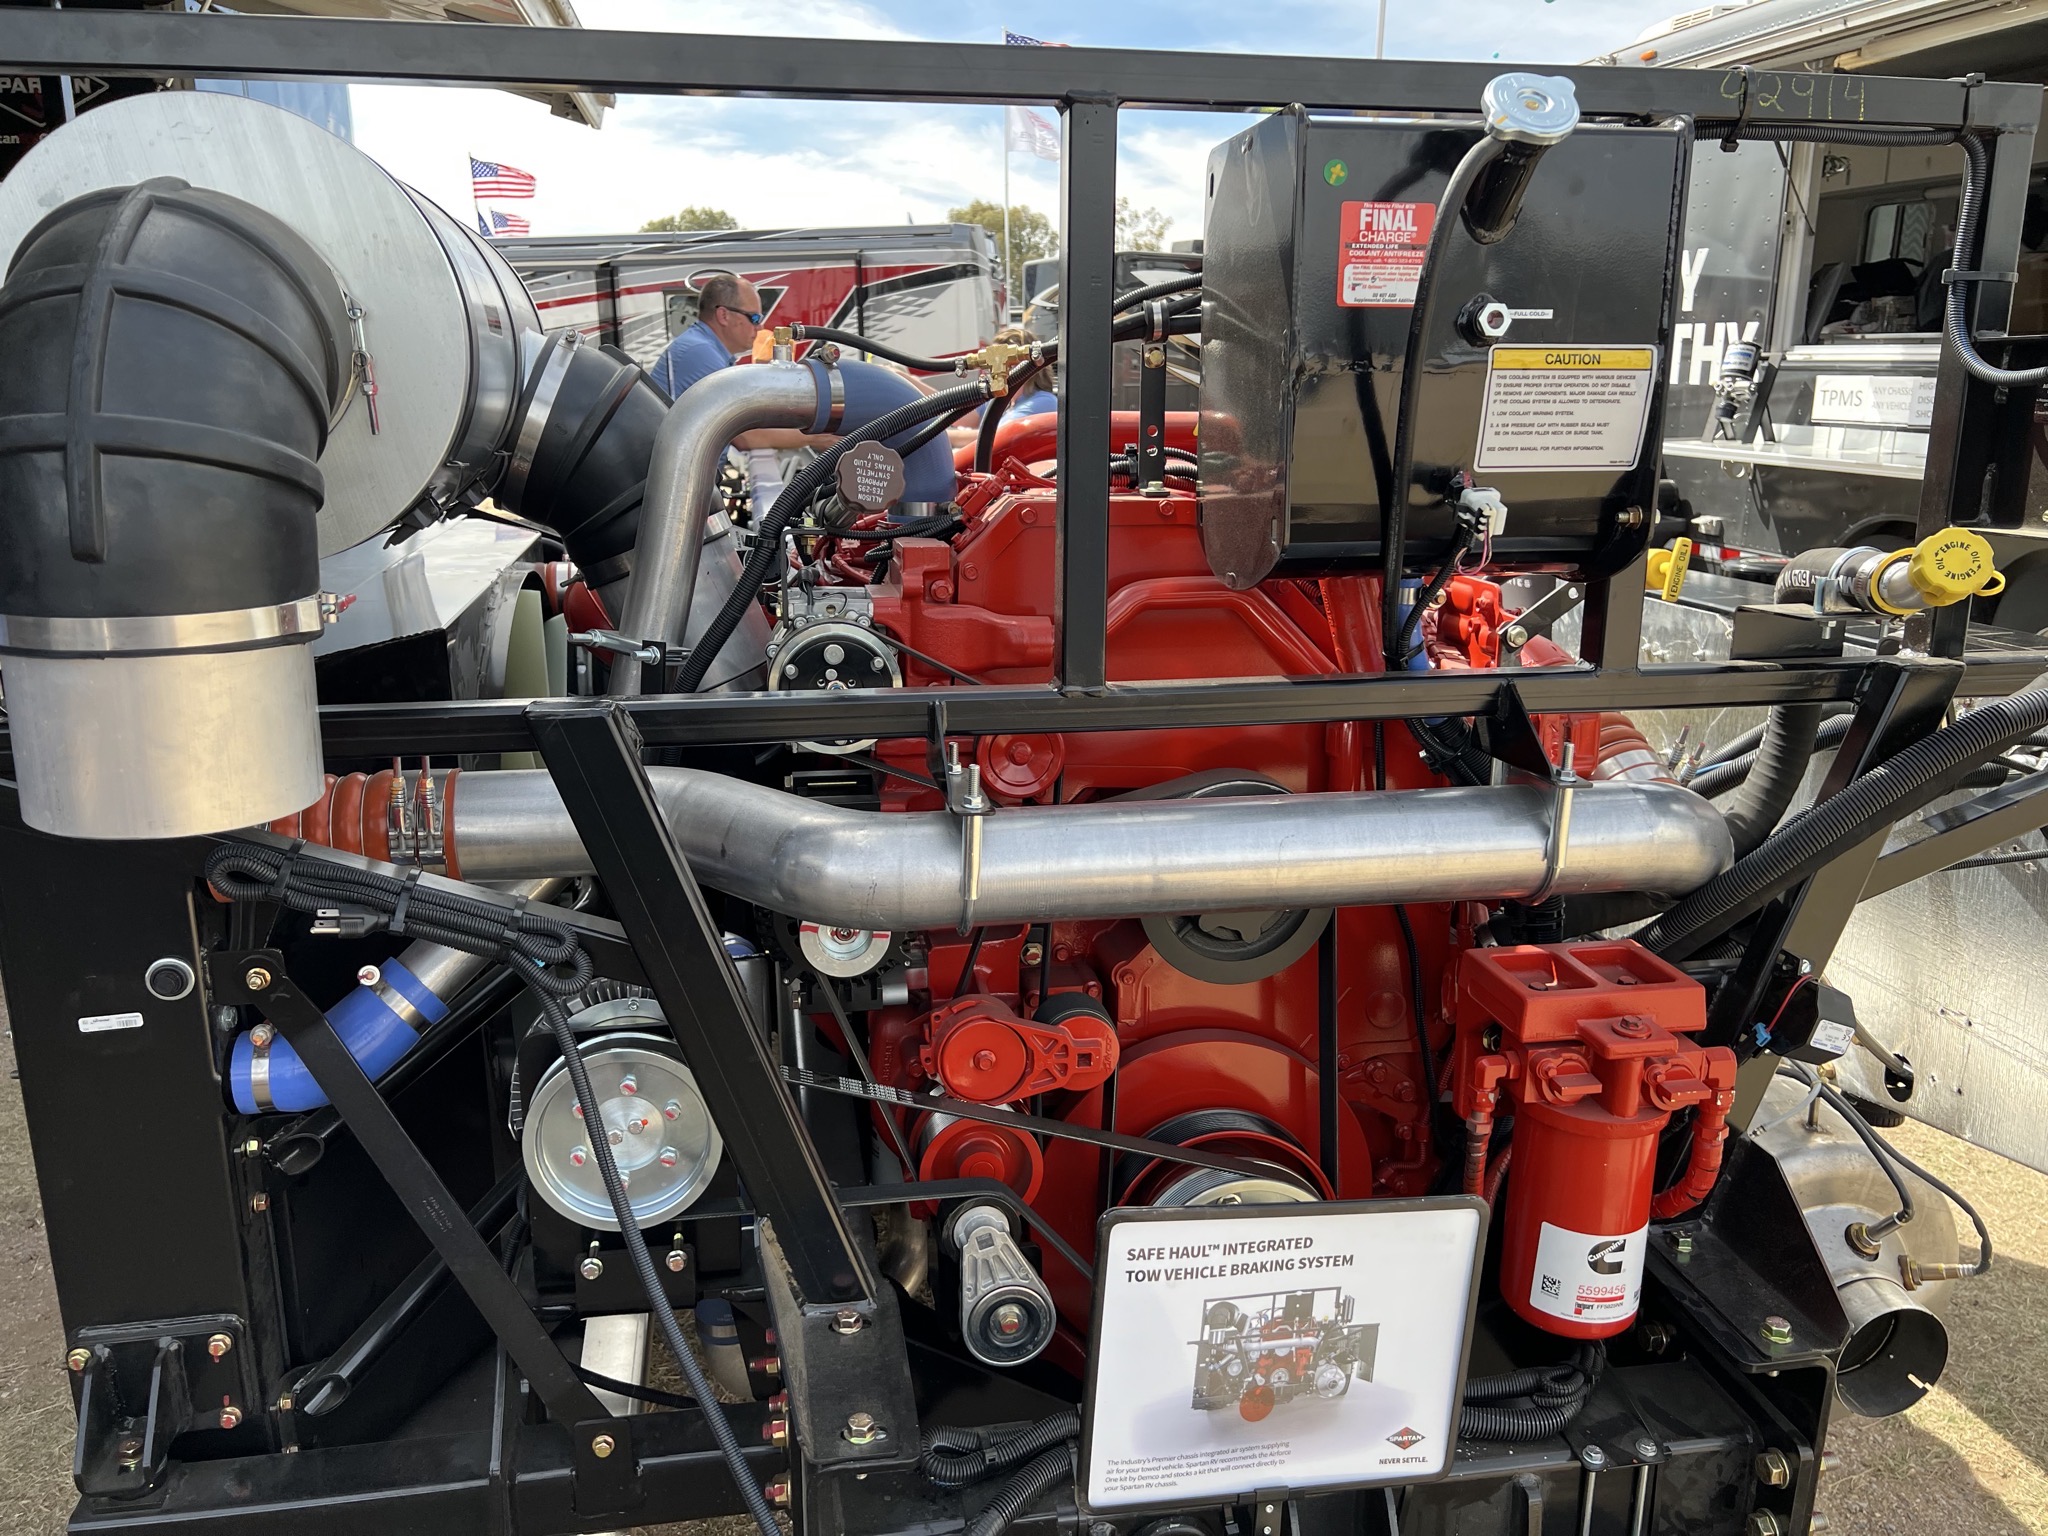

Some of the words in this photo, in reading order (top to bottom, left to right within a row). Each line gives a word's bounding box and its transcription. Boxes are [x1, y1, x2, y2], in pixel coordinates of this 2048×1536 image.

[1360, 209, 1418, 231] FINAL
[1545, 354, 1600, 365] CAUTION
[1820, 390, 1863, 406] TPMS
[867, 453, 884, 461] ONLY
[854, 459, 871, 468] FLUID
[875, 463, 894, 472] TRANS
[856, 468, 890, 479] SYNTHETIC
[857, 477, 887, 487] APPROVED
[858, 485, 883, 495] TES-295
[858, 493, 882, 503] ALLISON
[1940, 541, 1971, 553] ENGINE
[1971, 551, 1980, 563] OIL
[1936, 558, 1945, 570] OIL
[1671, 565, 1683, 593] ENGINE
[1679, 549, 1688, 561] OIL
[1945, 568, 1976, 580] ENGINE
[1127, 1248, 1165, 1261] SAFE
[1223, 1237, 1313, 1256] INTEGRATED
[1587, 1239, 1625, 1262] Cummins
[1126, 1269, 1161, 1282] TOW
[1165, 1265, 1227, 1280] VEHICLE
[1230, 1259, 1295, 1276] BRAKING
[1298, 1254, 1354, 1269] SYSTEM
[1578, 1284, 1626, 1296] 5599456
[1200, 1448, 1230, 1457] integrated
[1240, 1445, 1260, 1453] system
[1261, 1441, 1289, 1450] supplying
[1219, 1454, 1257, 1463] recommends
